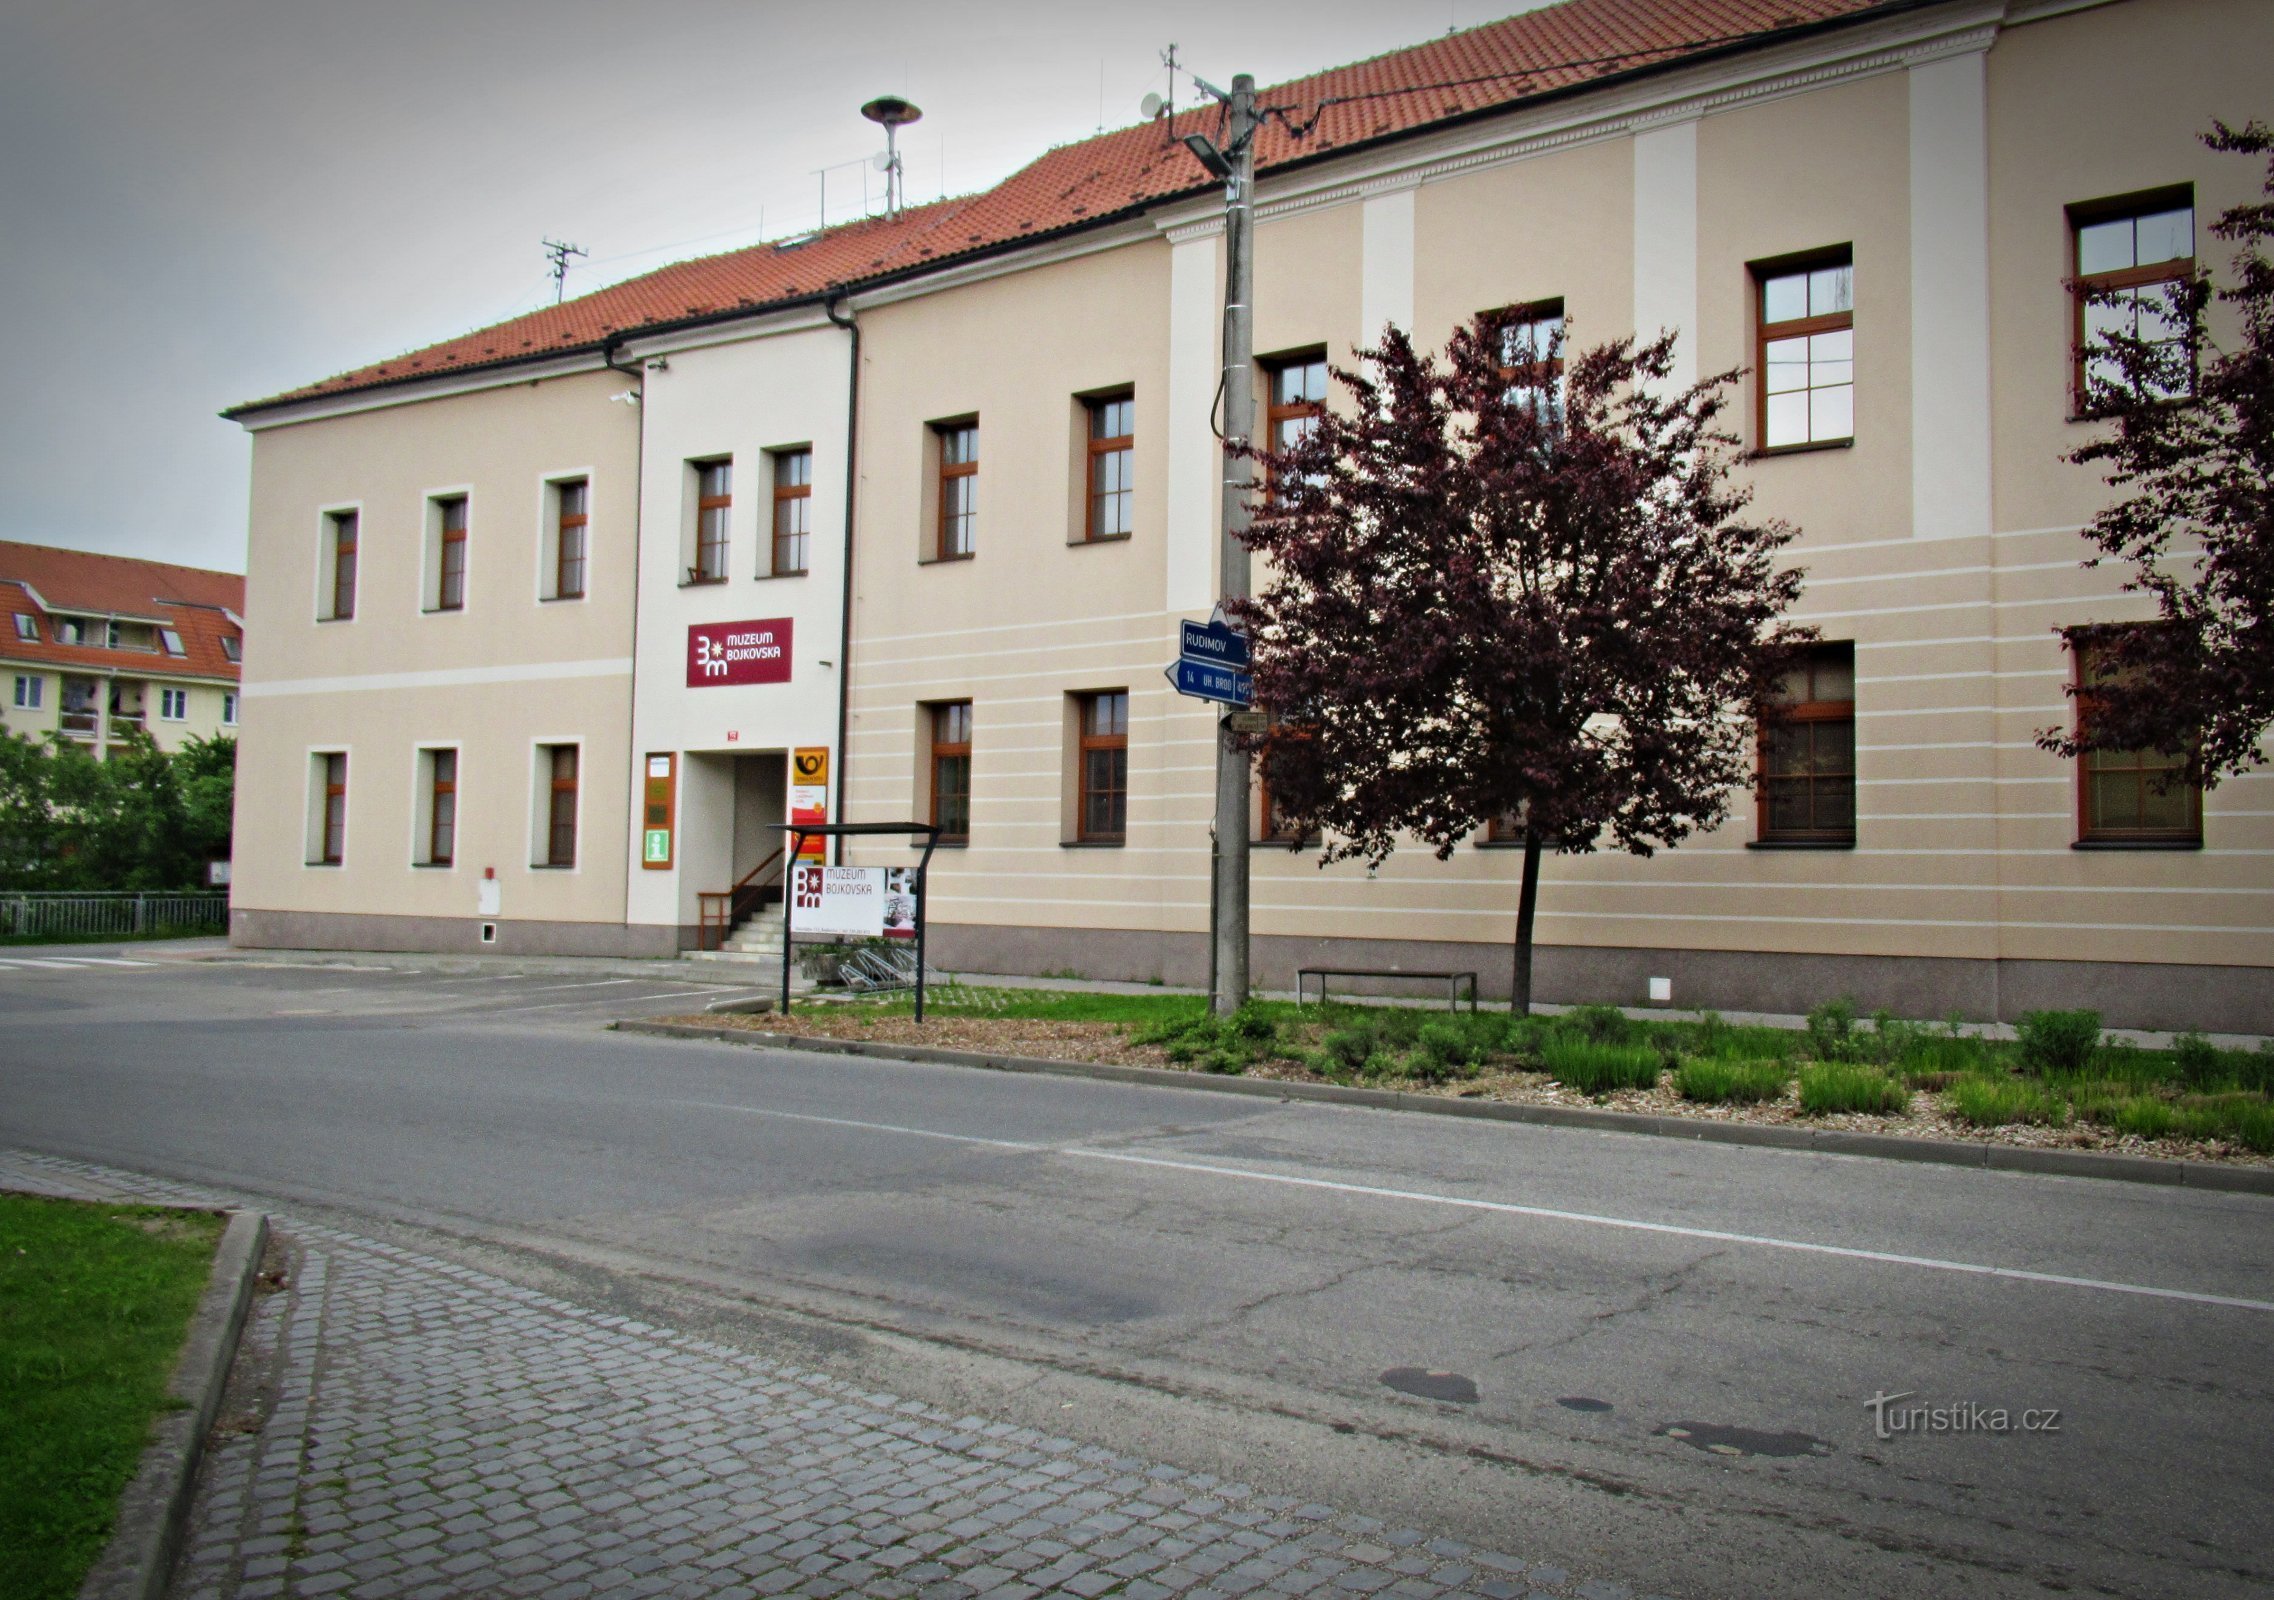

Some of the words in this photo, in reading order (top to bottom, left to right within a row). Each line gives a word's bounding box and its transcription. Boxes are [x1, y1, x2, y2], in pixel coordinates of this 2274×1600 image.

[727, 632, 773, 646] MUZEUM
[1186, 632, 1227, 653] RUDIMOV
[726, 646, 781, 661] BOJKOVSKA
[1186, 670, 1195, 684] 14
[1203, 674, 1214, 688] UH.
[1215, 676, 1232, 691] BROD
[826, 868, 866, 881] MUZEUM
[826, 883, 873, 896] BOJKOVSKA
